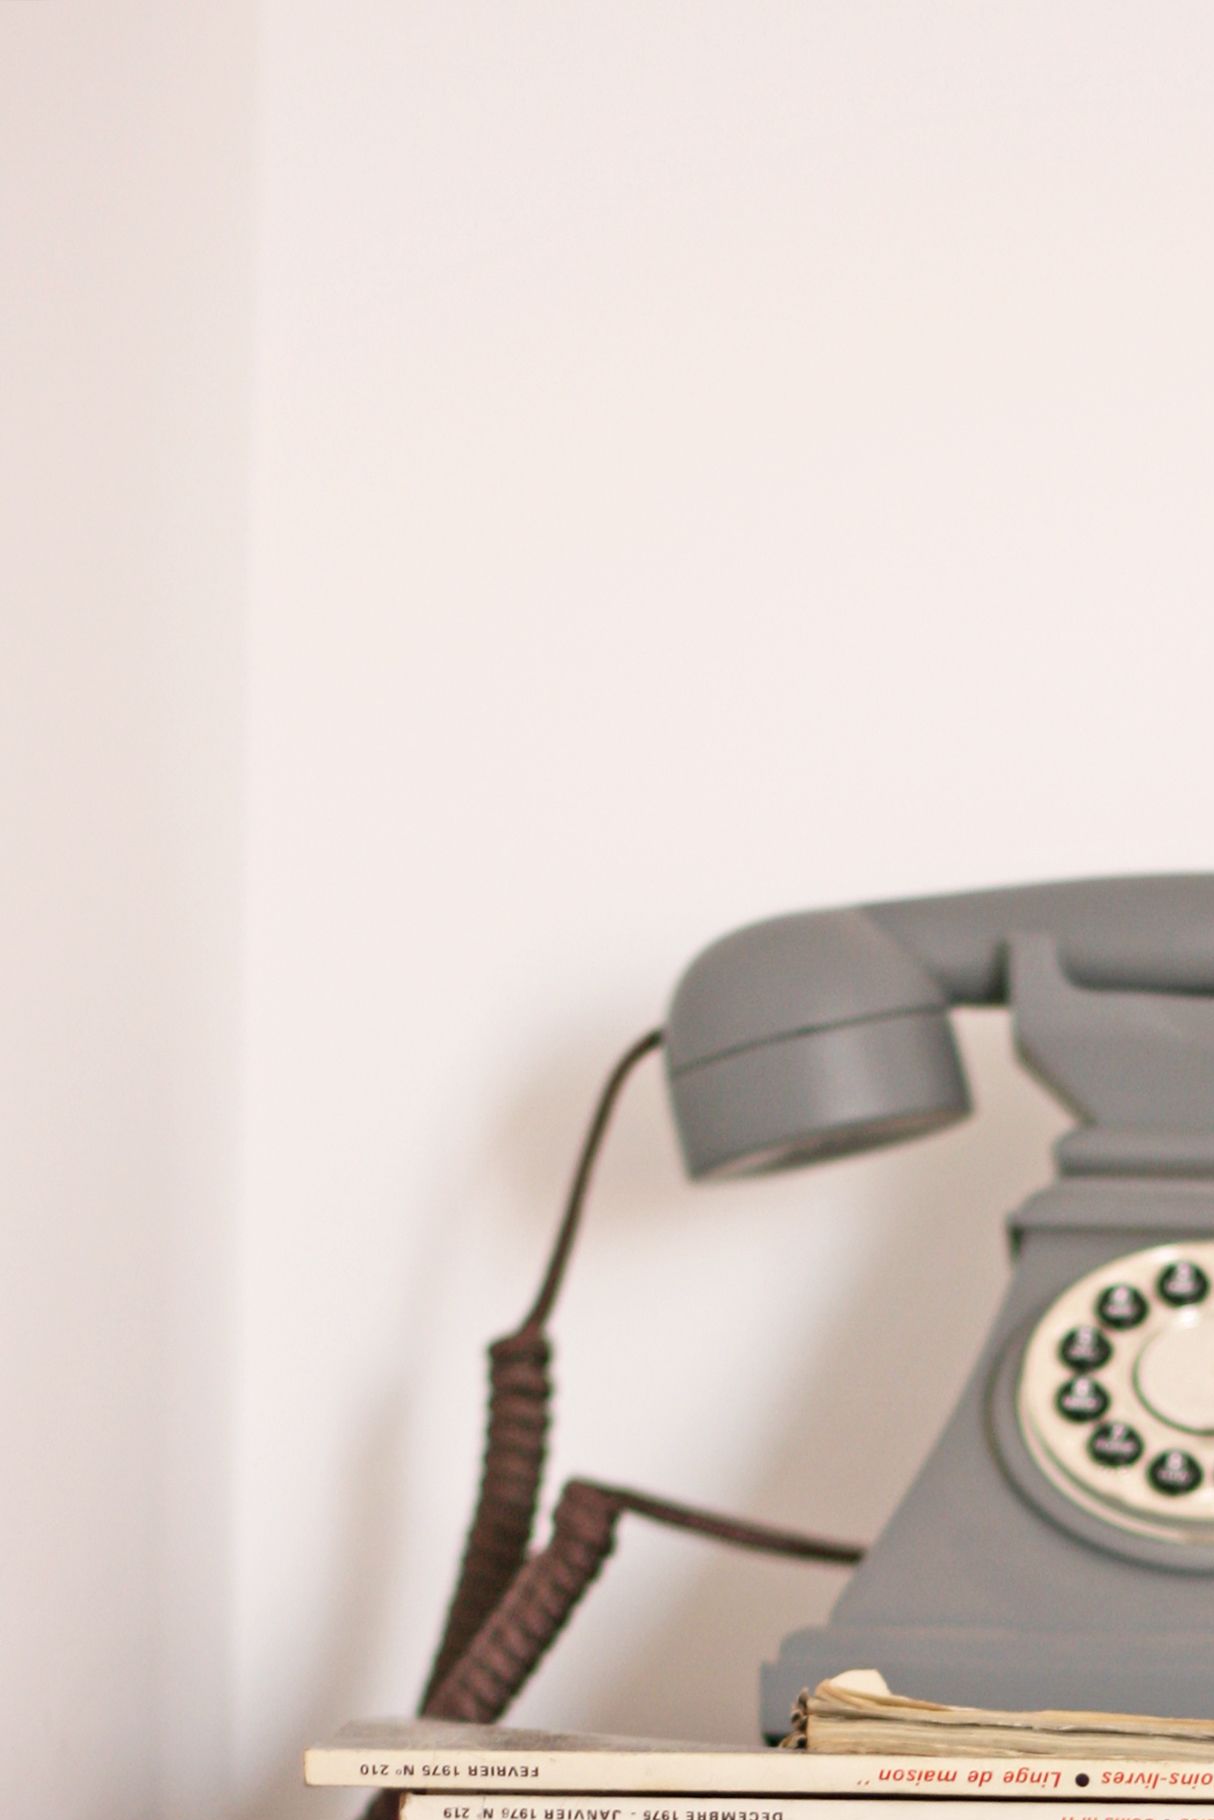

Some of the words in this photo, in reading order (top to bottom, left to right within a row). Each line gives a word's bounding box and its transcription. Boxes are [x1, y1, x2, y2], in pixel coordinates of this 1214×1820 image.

[359, 1764, 389, 1776] 210
[422, 1765, 461, 1777] 1975
[467, 1766, 539, 1778] FEVRIER
[968, 1771, 993, 1787] de
[1003, 1767, 1062, 1788] Linge
[443, 1807, 470, 1819] 219
[501, 1807, 537, 1819] 1976
[544, 1809, 622, 1820] JANVIER
